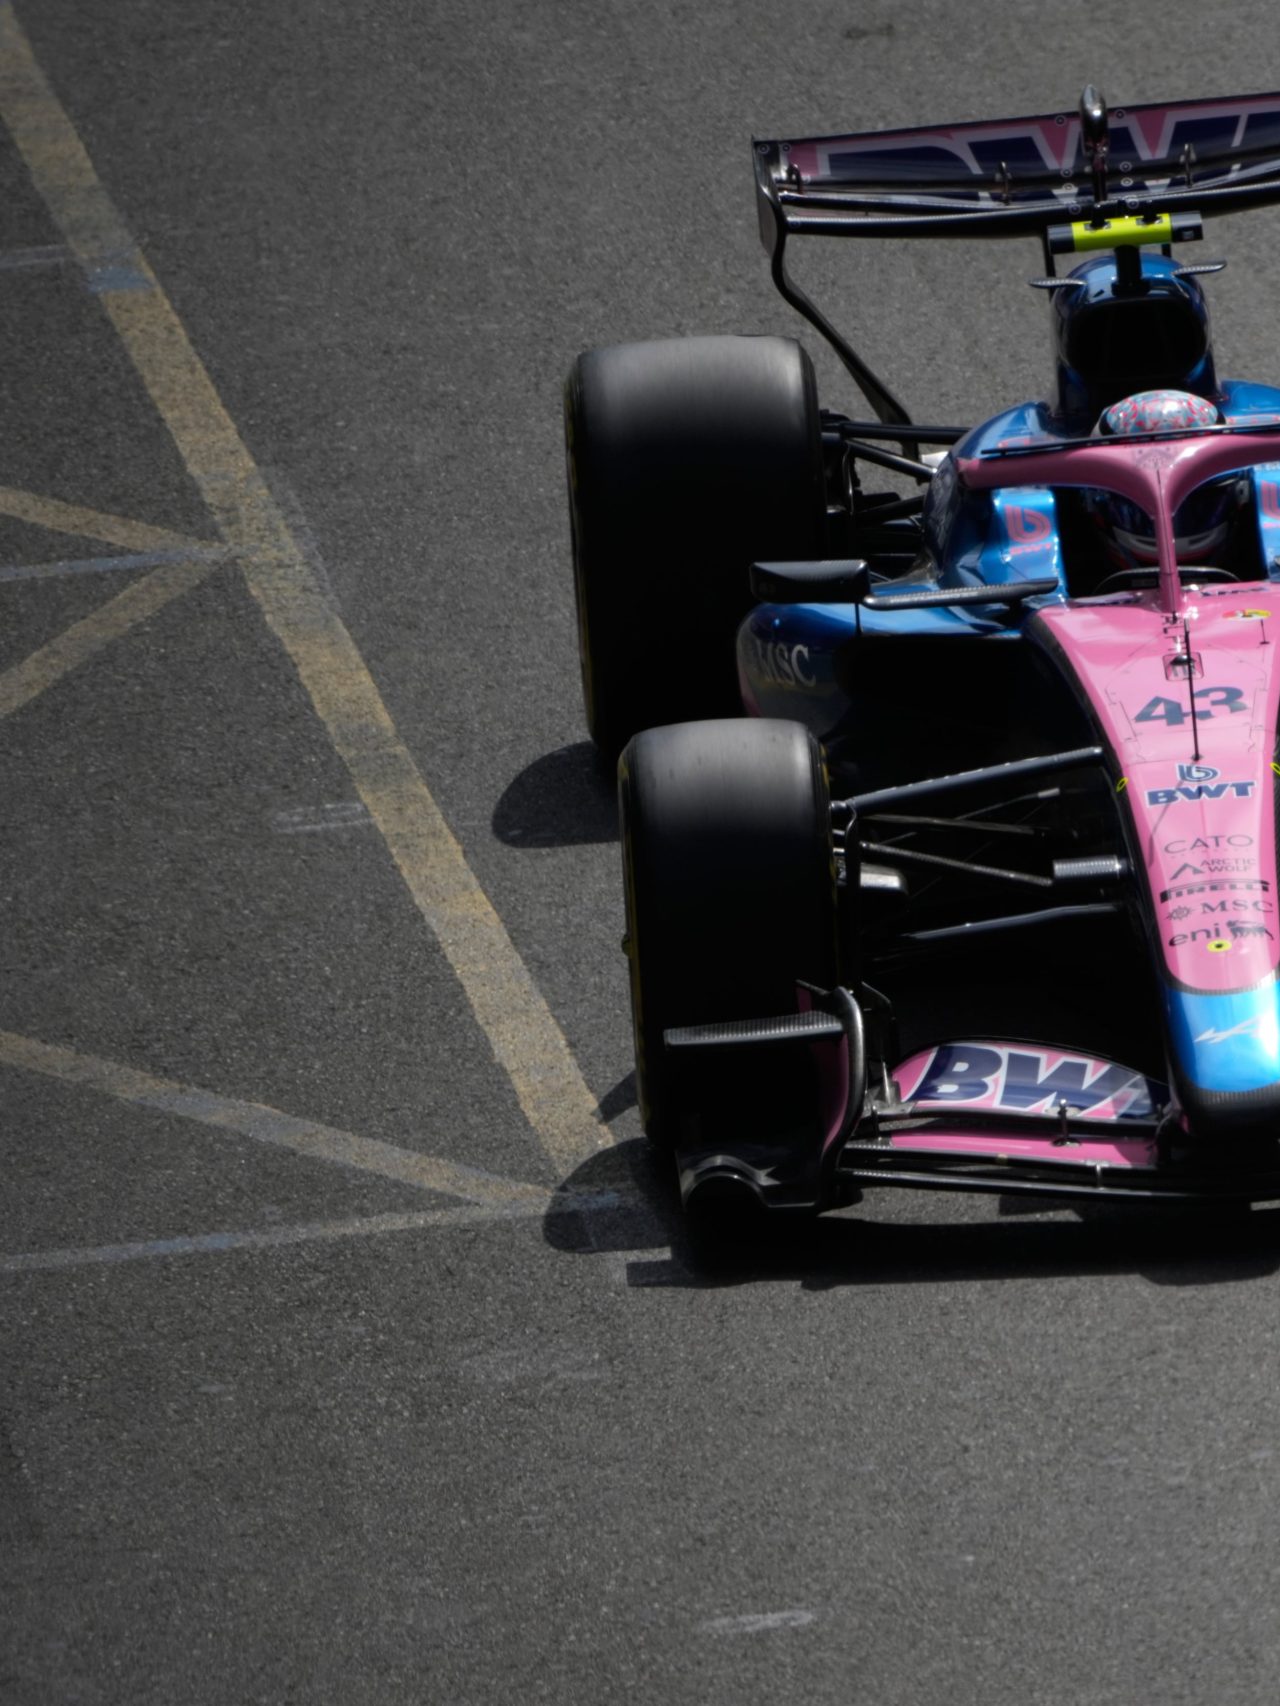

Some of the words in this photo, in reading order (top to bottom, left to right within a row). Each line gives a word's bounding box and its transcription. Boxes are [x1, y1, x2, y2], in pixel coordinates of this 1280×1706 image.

[754, 640, 816, 687] MSC
[1134, 686, 1248, 726] 43
[1147, 781, 1255, 806] BWT
[1164, 834, 1253, 854] CATO
[1200, 858, 1256, 867] ARCTIC
[1208, 865, 1250, 873] WOLF
[1160, 879, 1269, 904] PIRELLI
[1201, 899, 1274, 914] MSC
[1168, 923, 1221, 947] eni
